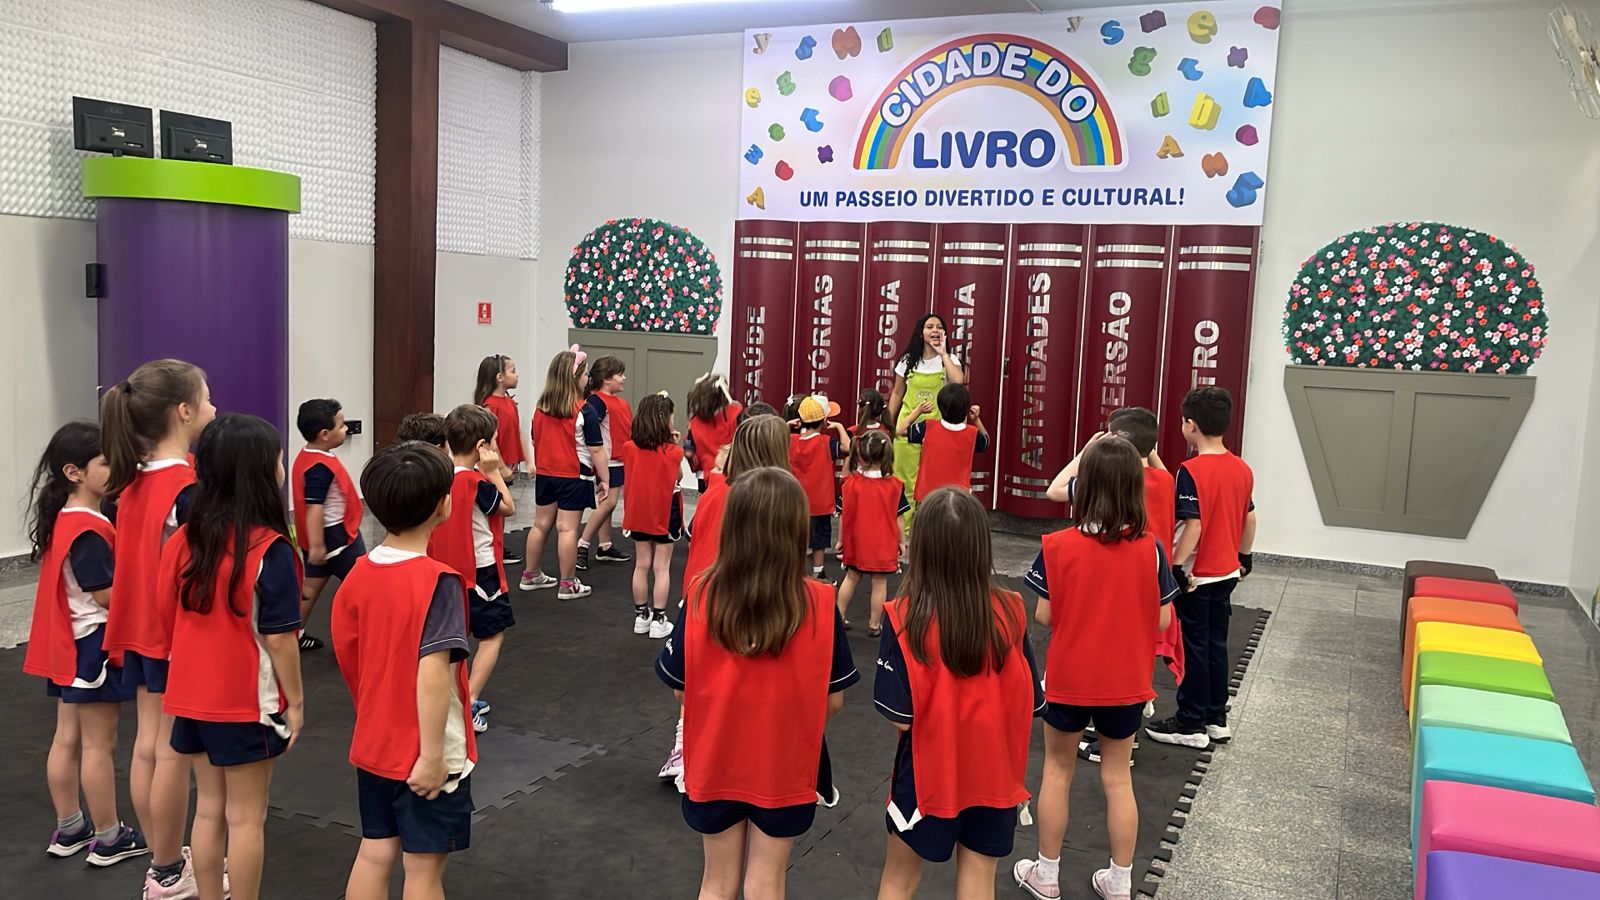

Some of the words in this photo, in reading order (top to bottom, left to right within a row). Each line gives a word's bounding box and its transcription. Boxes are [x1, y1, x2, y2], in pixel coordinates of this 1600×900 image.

[881, 42, 1032, 127] CIDADE
[1035, 58, 1097, 122] DO
[912, 128, 1056, 169] LIVRO
[800, 191, 828, 207] UM
[836, 190, 918, 207] PASSEIO
[925, 189, 1034, 206] DIVERTIDO
[1042, 189, 1054, 206] E
[1062, 187, 1185, 206] CULTURAL!
[743, 305, 766, 406] SAÚDE
[1021, 272, 1051, 471] ATIVIDADES
